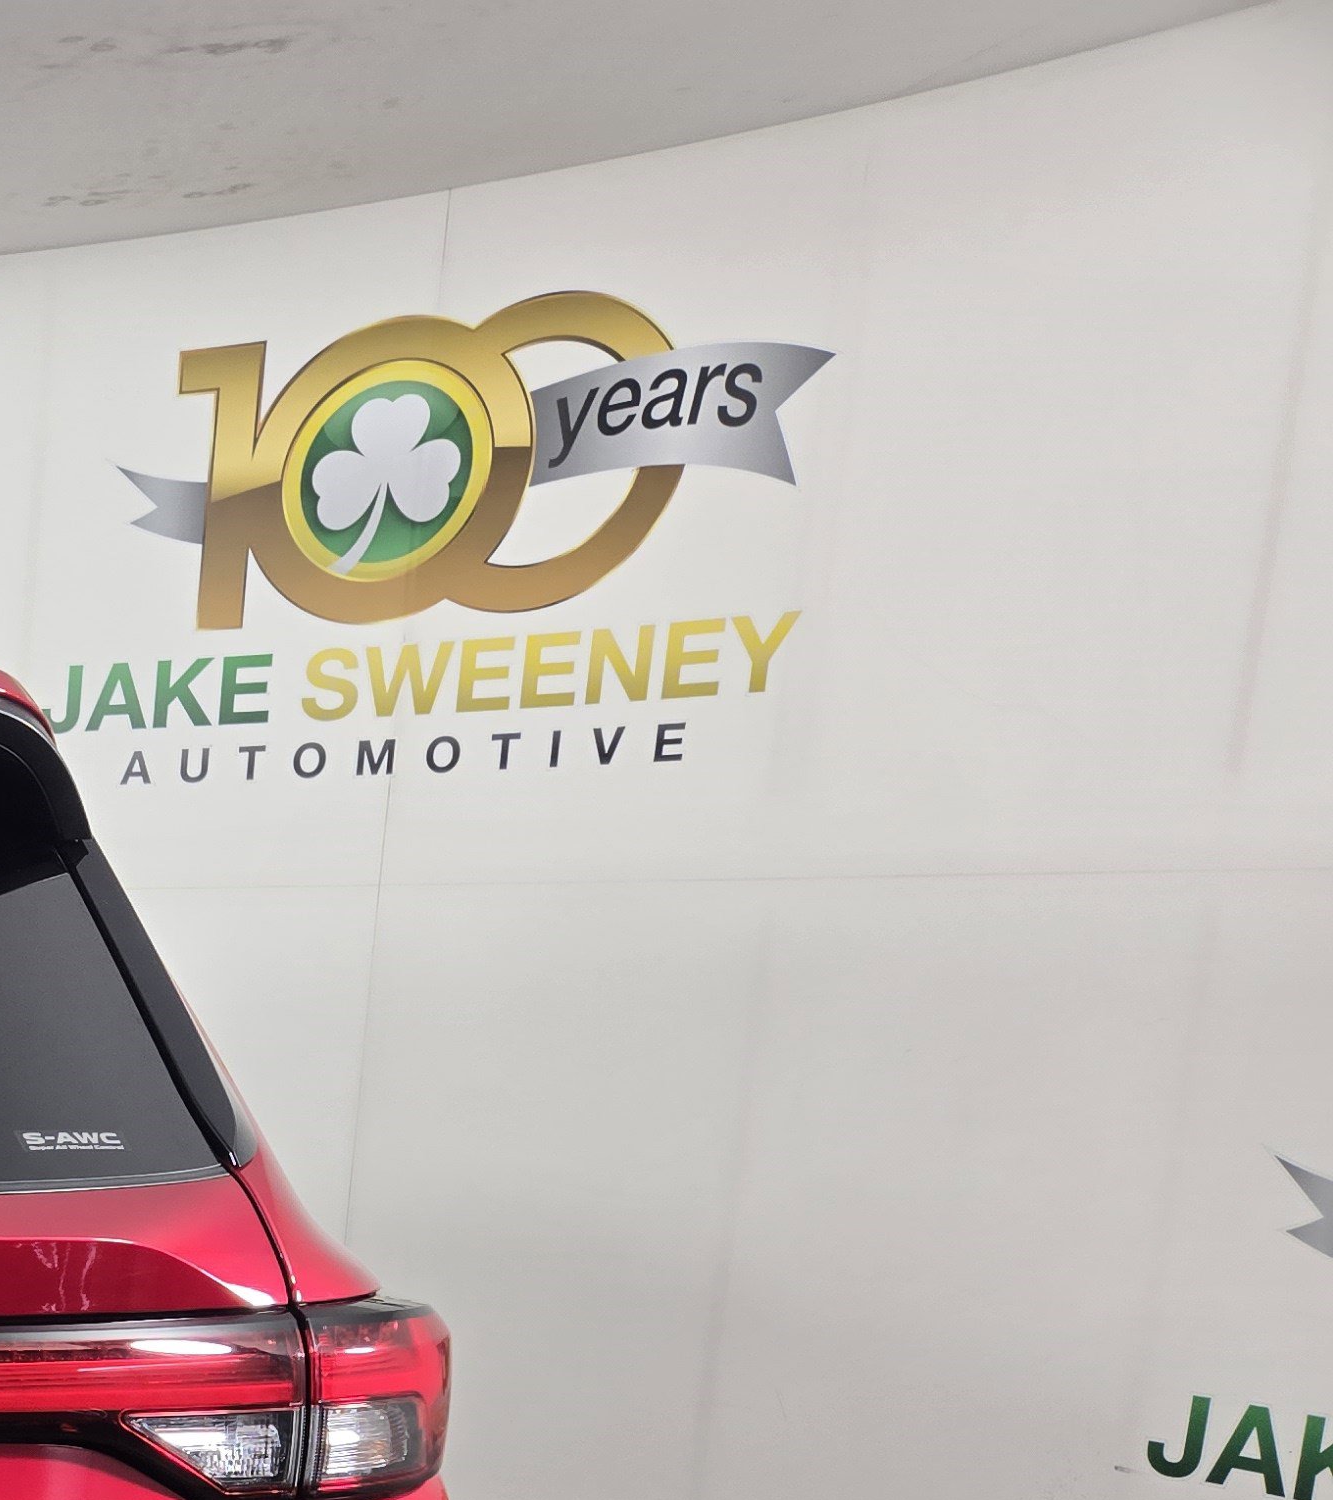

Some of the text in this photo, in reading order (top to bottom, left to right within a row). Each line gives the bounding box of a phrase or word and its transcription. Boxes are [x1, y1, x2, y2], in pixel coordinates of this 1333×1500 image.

[177, 290, 686, 630] 100
[548, 362, 763, 469] years
[41, 610, 802, 733] JAKE SWEENEY
[119, 722, 687, 786] AUTOMOTIVE
[22, 1132, 121, 1145] S-AWC
